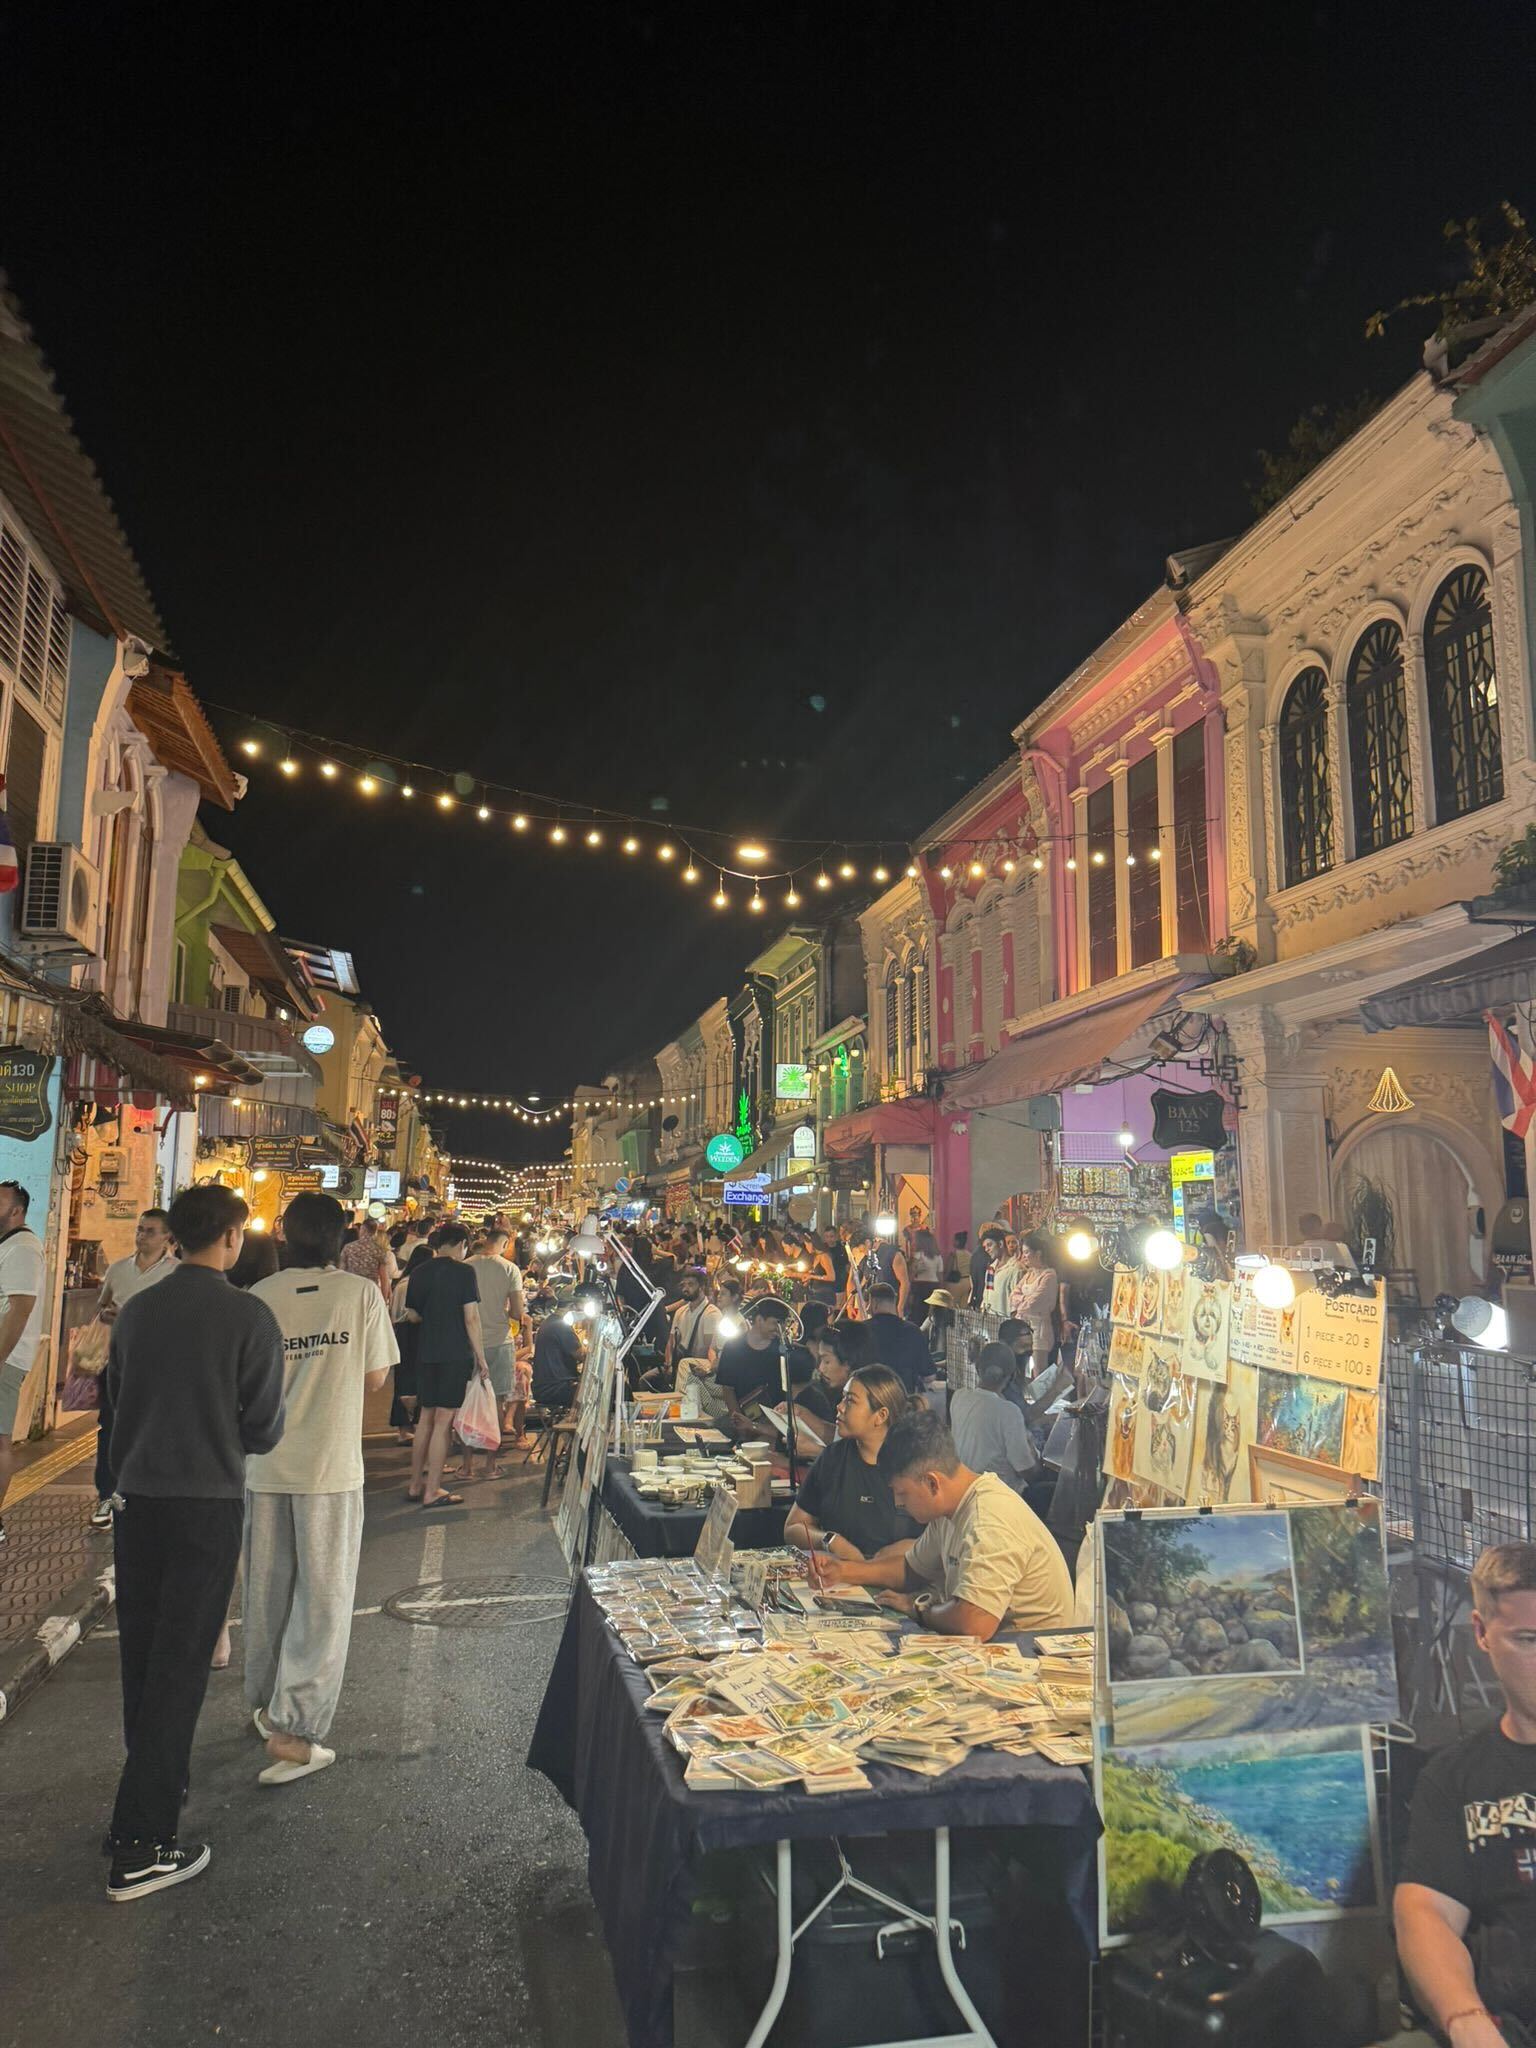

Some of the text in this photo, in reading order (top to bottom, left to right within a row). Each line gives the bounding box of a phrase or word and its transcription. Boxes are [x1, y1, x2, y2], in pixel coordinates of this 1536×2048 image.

[5, 1082, 36, 1092] SHOP
[1168, 1105, 1209, 1118] BAAN
[1178, 1120, 1201, 1132] 125
[726, 1191, 769, 1203] Exchange
[1325, 1298, 1377, 1316] POSTCARD
[1345, 1332, 1359, 1346] 20
[1303, 1351, 1311, 1363] 6
[1344, 1359, 1363, 1375] 100
